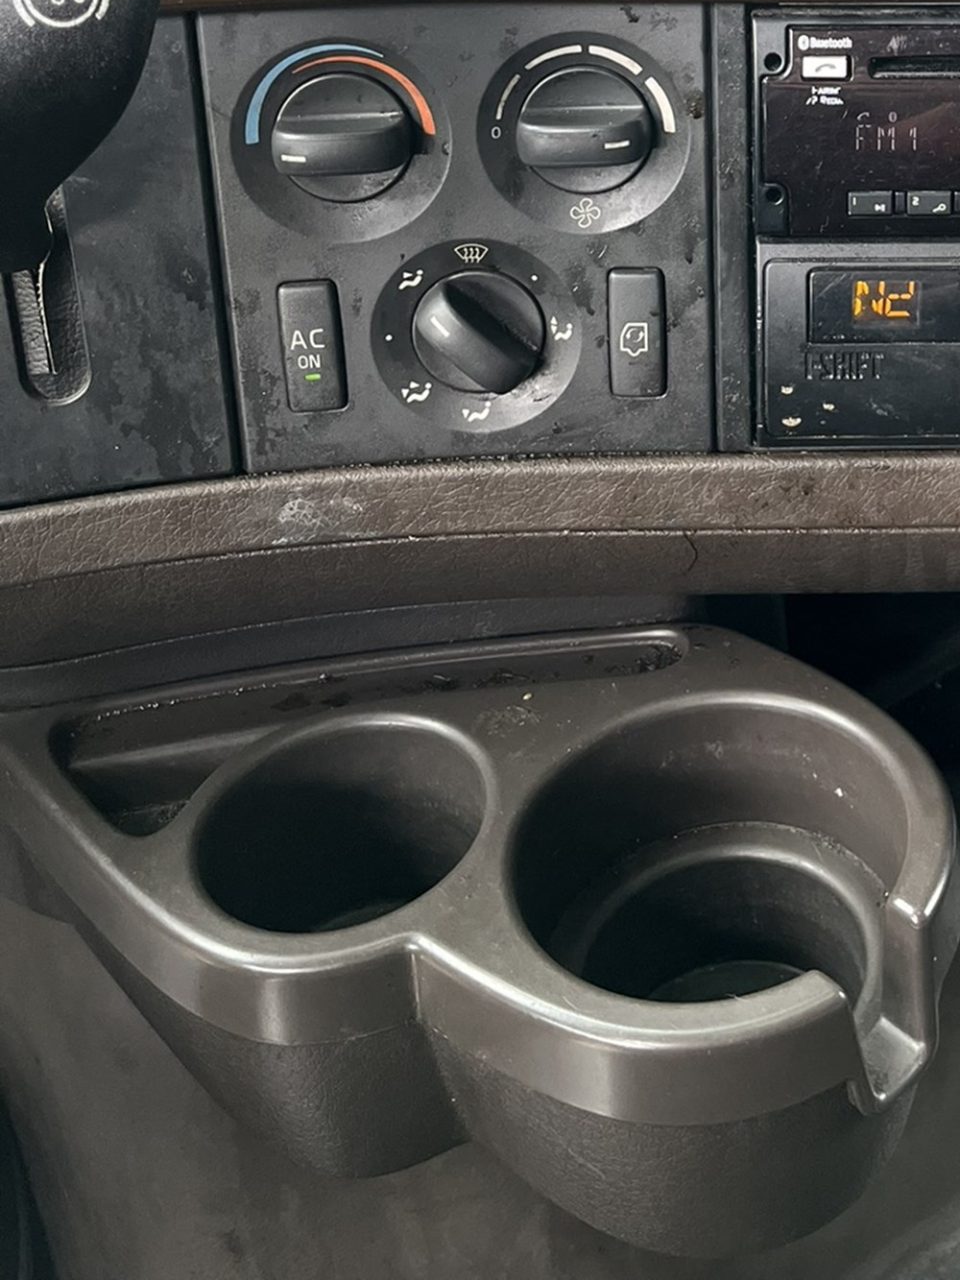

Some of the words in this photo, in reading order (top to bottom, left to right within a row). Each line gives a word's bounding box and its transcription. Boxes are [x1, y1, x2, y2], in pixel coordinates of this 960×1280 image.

[855, 124, 917, 151] FM1
[912, 196, 920, 206] 2
[290, 329, 325, 350] AC
[297, 354, 321, 369] ON
